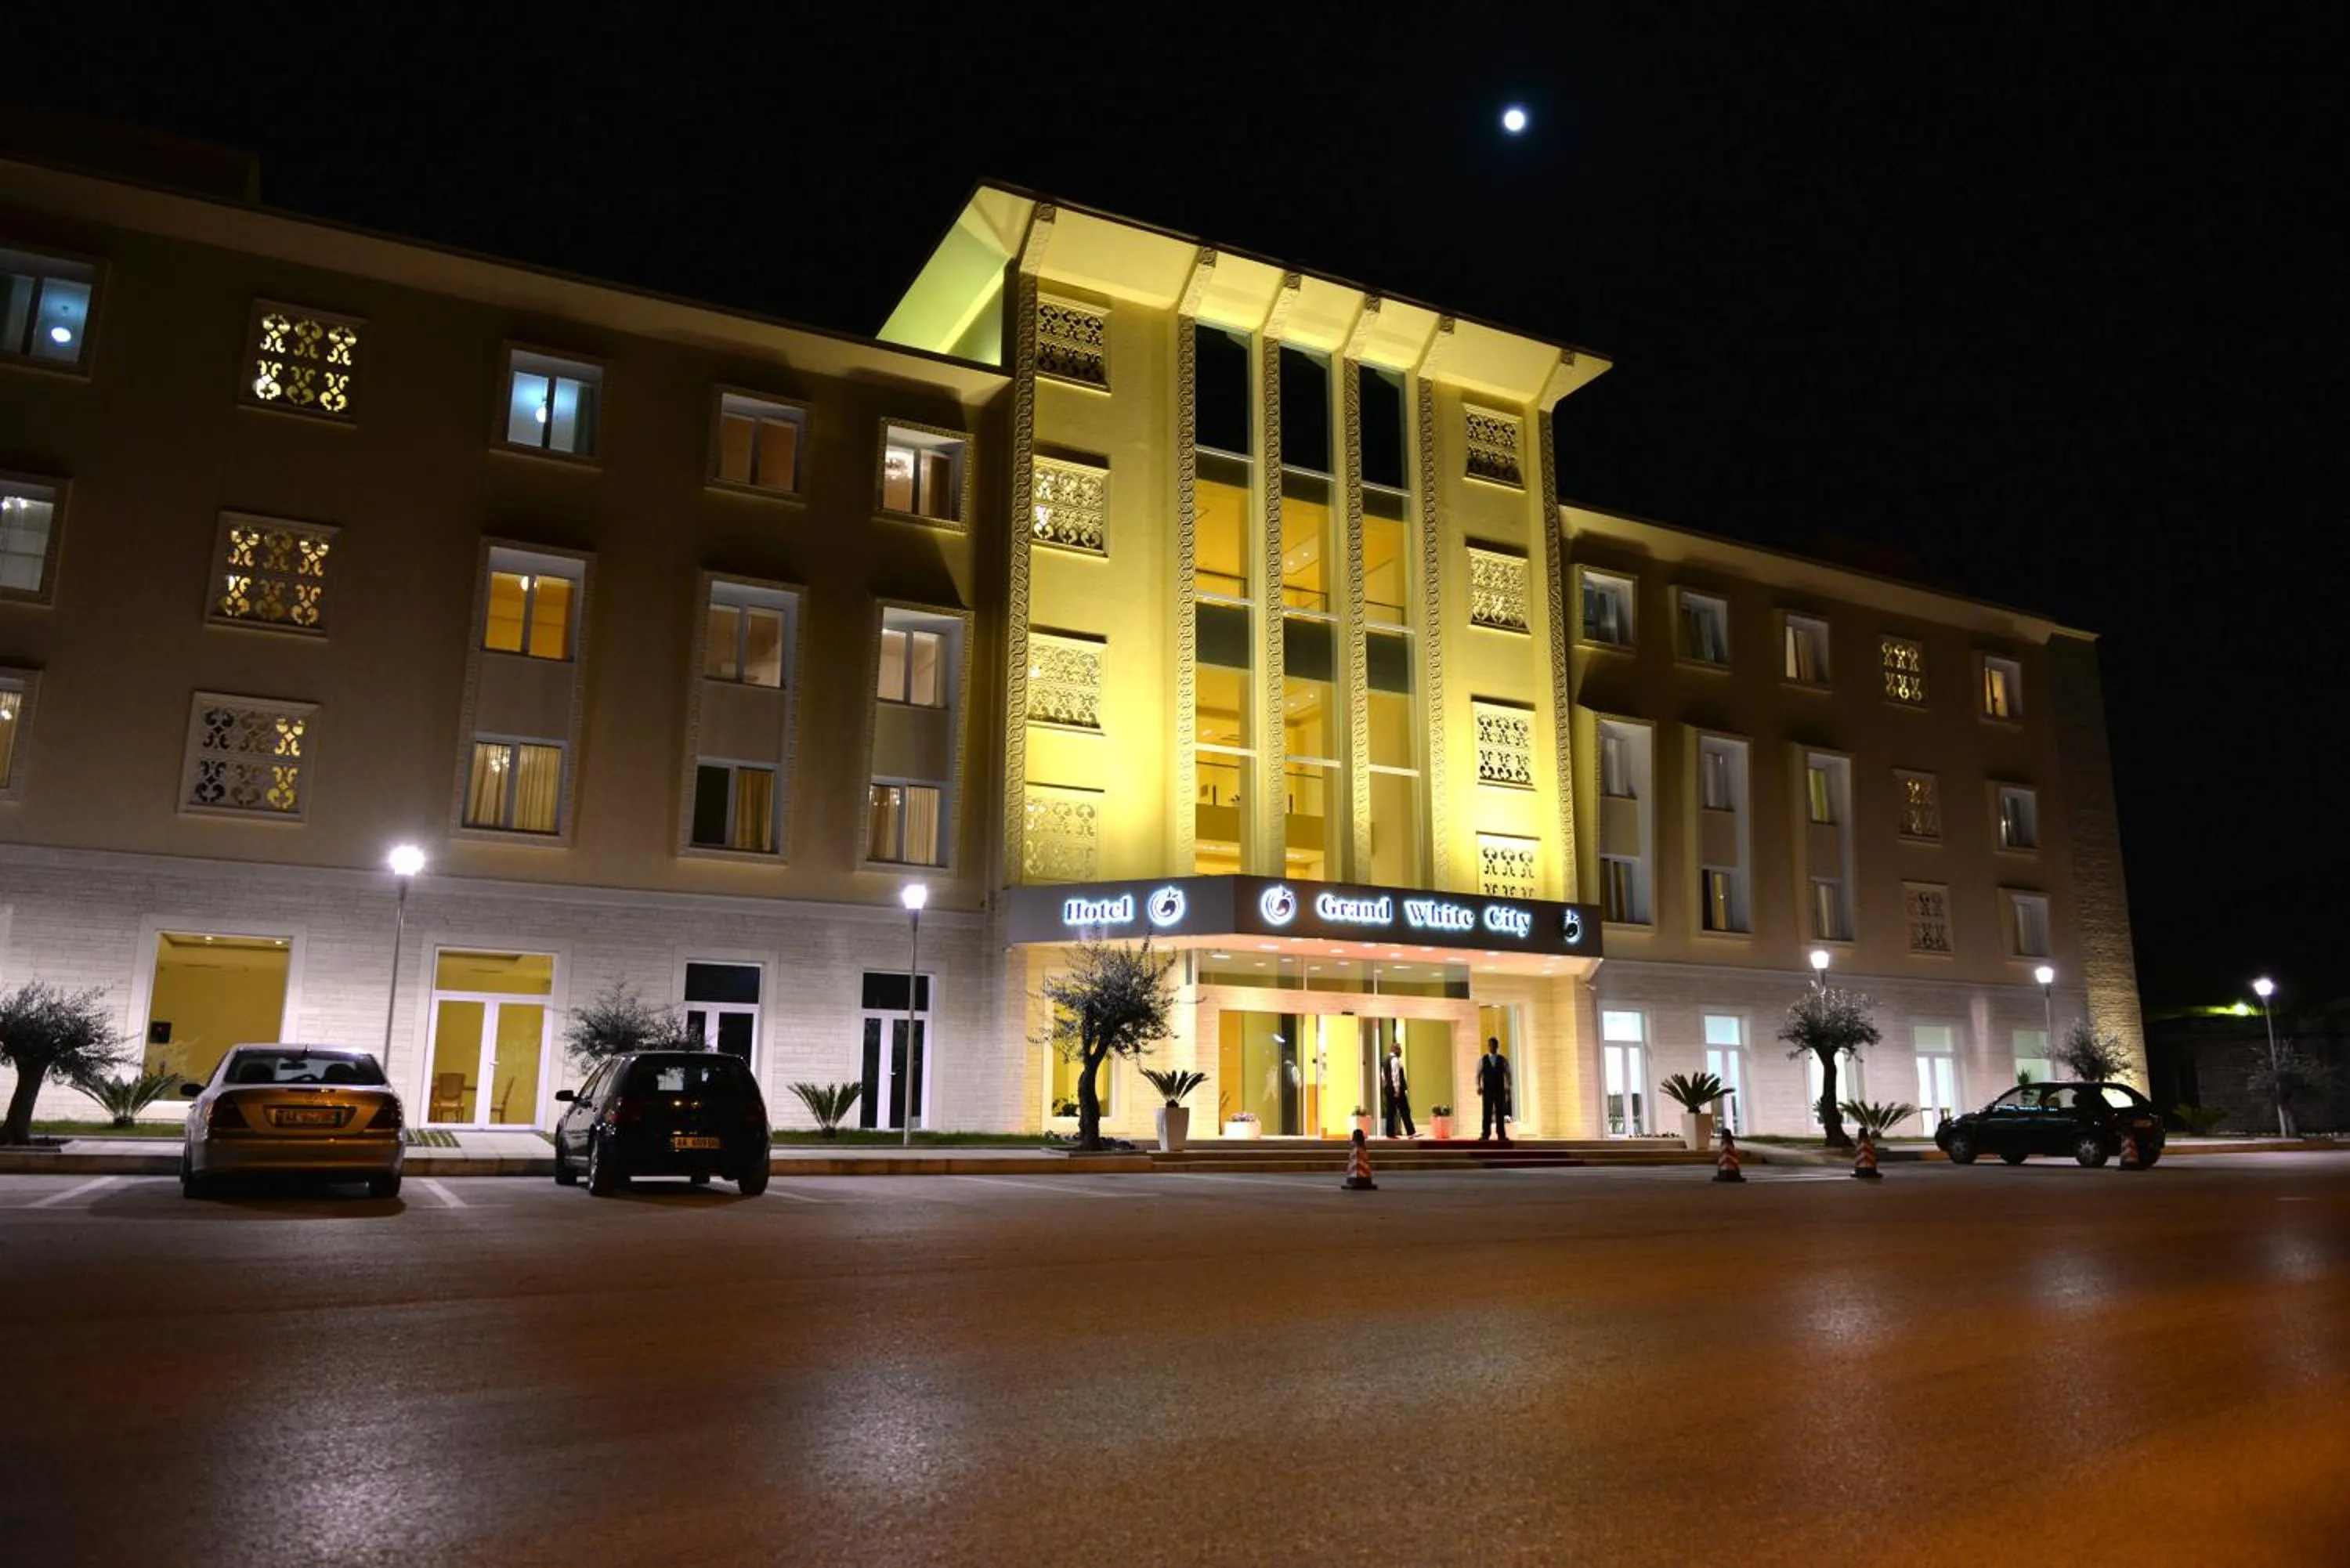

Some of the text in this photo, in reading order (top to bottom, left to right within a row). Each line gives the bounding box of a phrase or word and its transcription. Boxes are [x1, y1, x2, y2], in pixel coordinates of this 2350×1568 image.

[1064, 894, 1133, 923] Hotel
[1318, 894, 1531, 938] Grand White City
